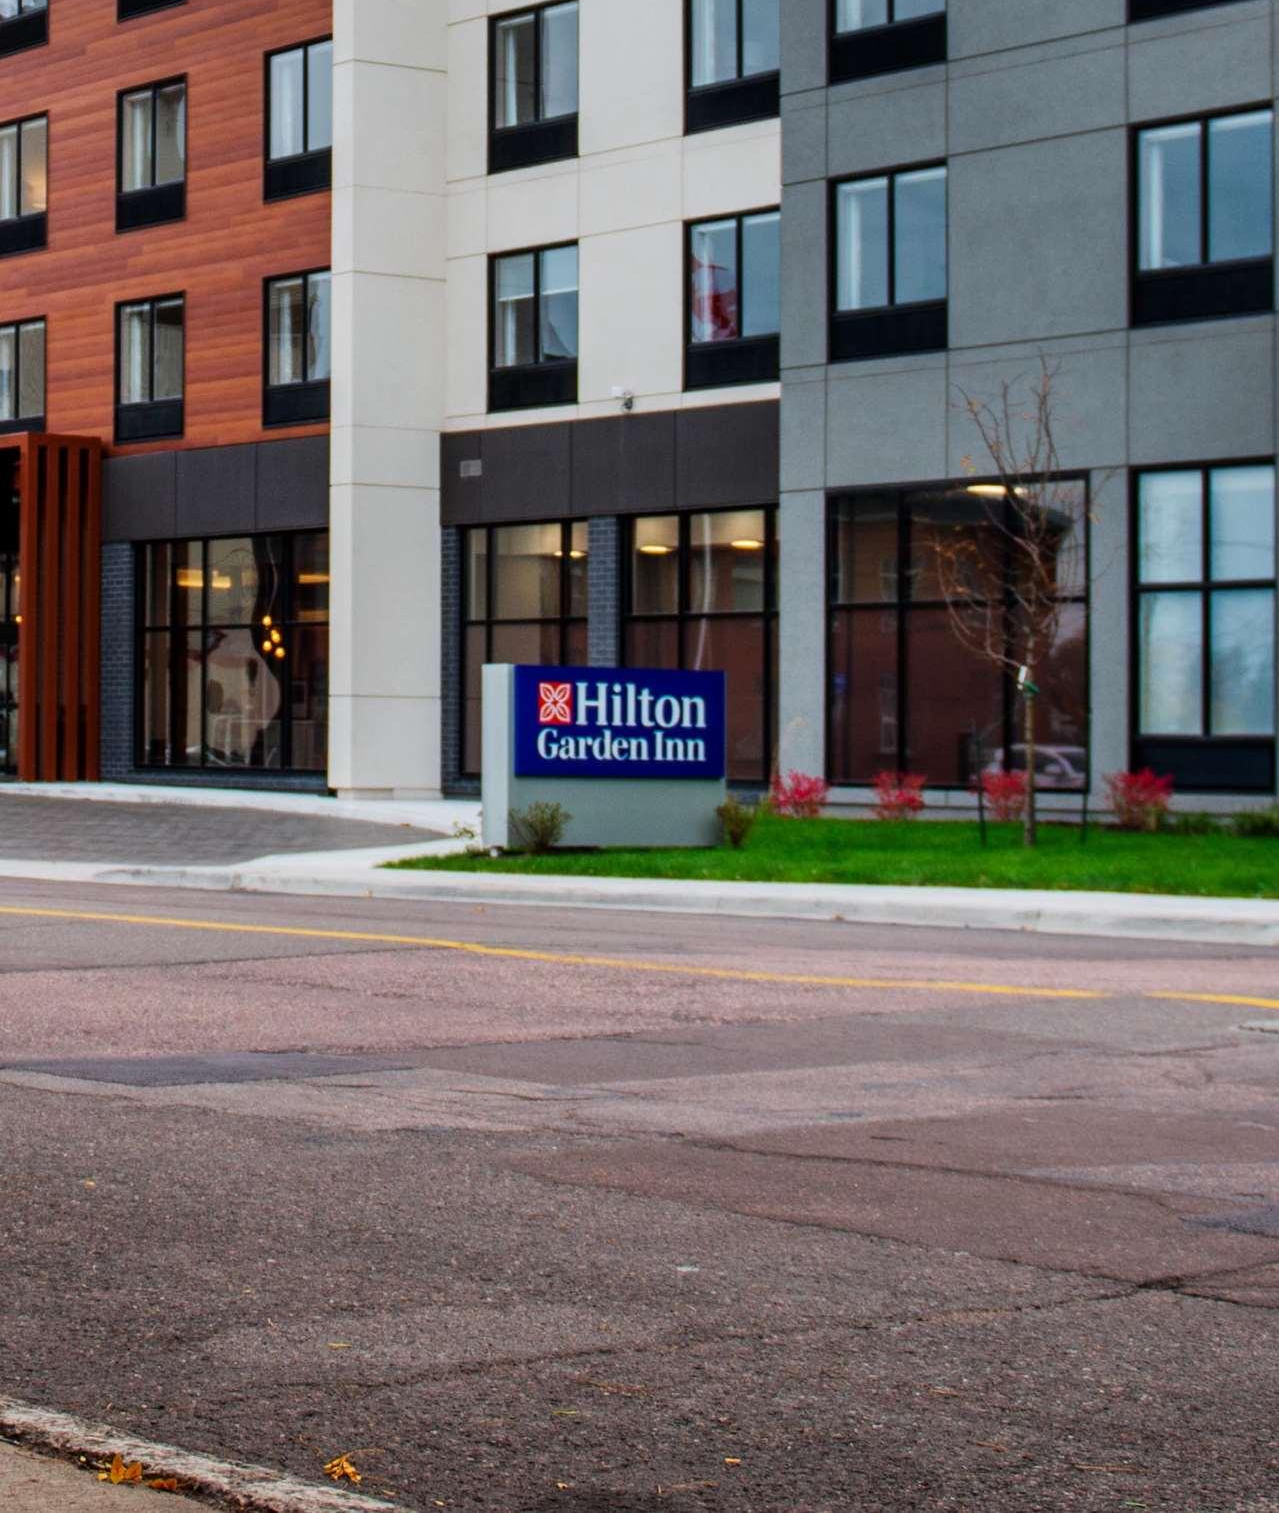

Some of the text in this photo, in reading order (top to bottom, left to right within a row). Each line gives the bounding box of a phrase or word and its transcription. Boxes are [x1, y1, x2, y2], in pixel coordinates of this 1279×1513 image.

[575, 682, 707, 728] Hilton
[536, 727, 706, 762] Garden Inn
